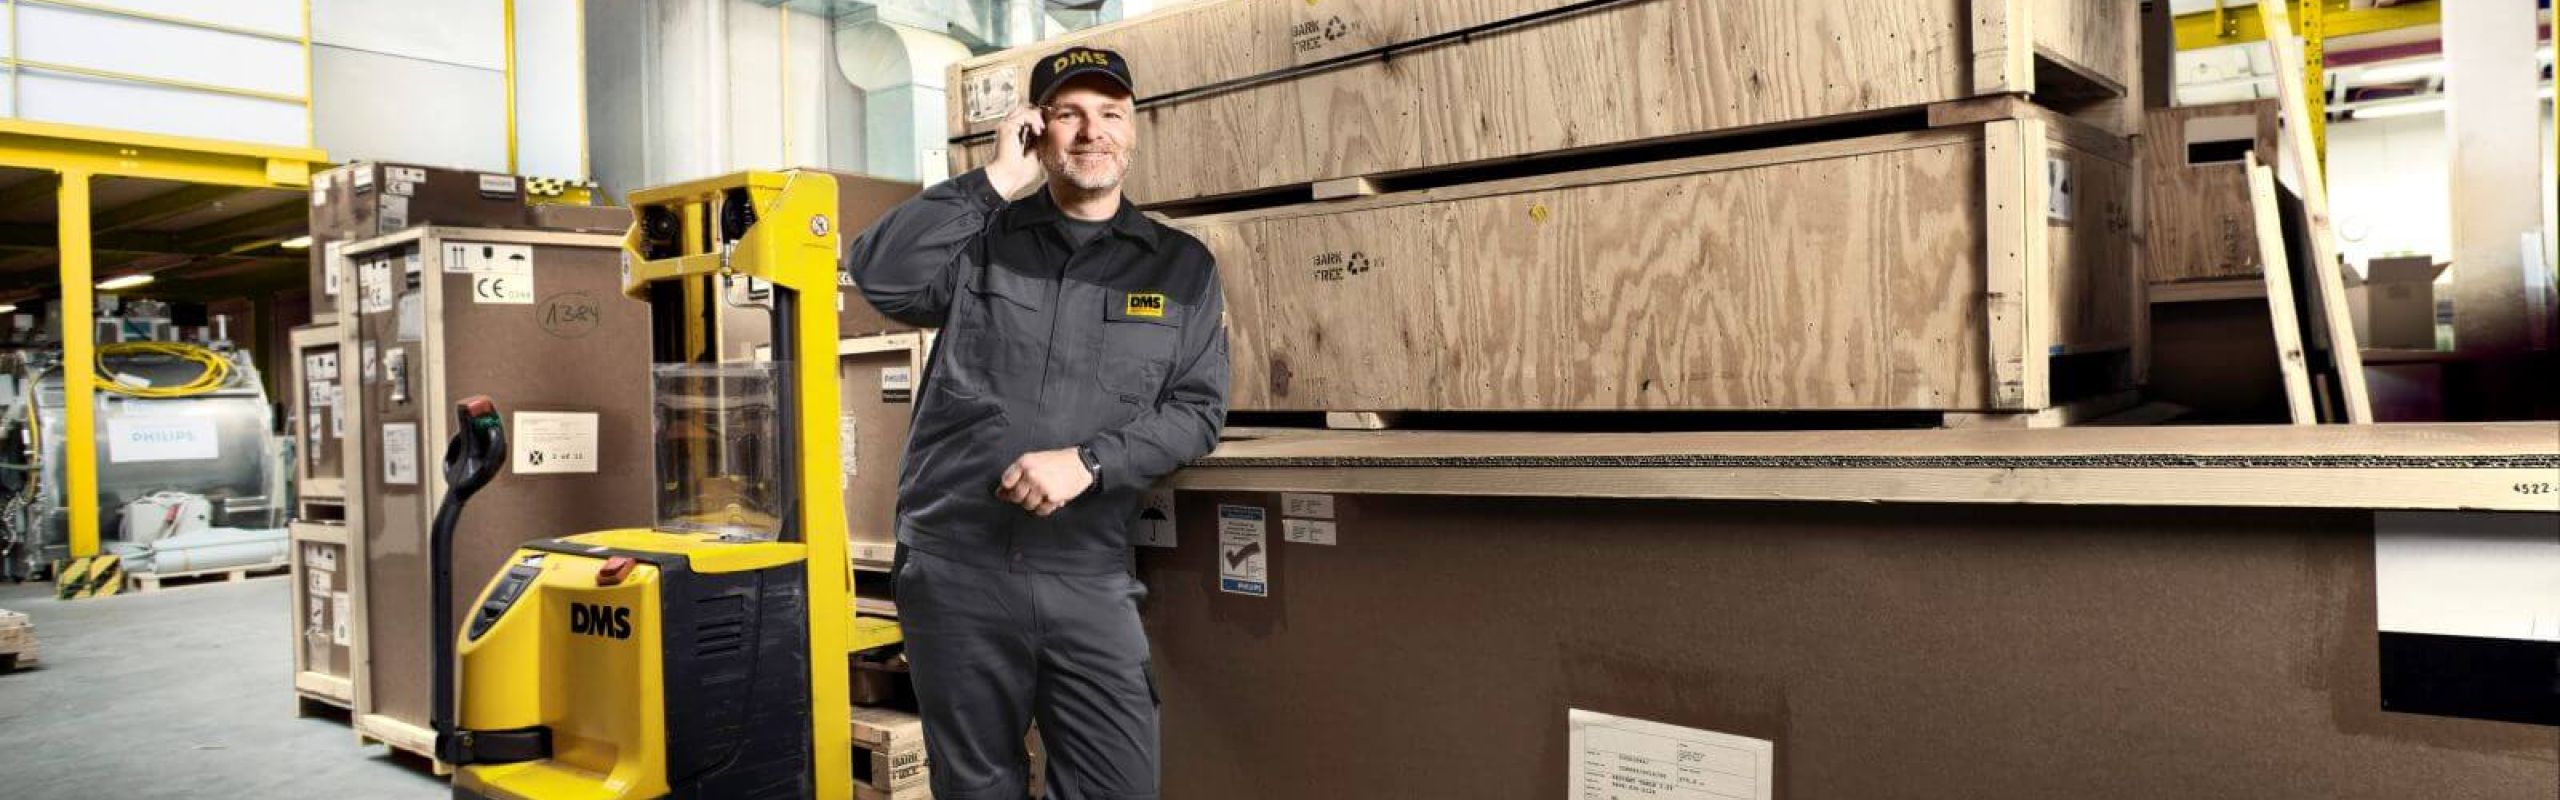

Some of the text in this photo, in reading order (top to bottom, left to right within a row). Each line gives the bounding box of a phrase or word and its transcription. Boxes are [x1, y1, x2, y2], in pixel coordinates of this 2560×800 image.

[1291, 21, 1319, 37] BARK
[1292, 36, 1321, 53] FREE
[1054, 52, 1109, 74] DMS
[1313, 252, 1342, 266] BARK
[1314, 268, 1344, 281] FREE
[478, 278, 504, 298] CE
[1130, 297, 1161, 309] DMS
[131, 430, 196, 443] PHILIPS
[570, 602, 632, 639] DMS
